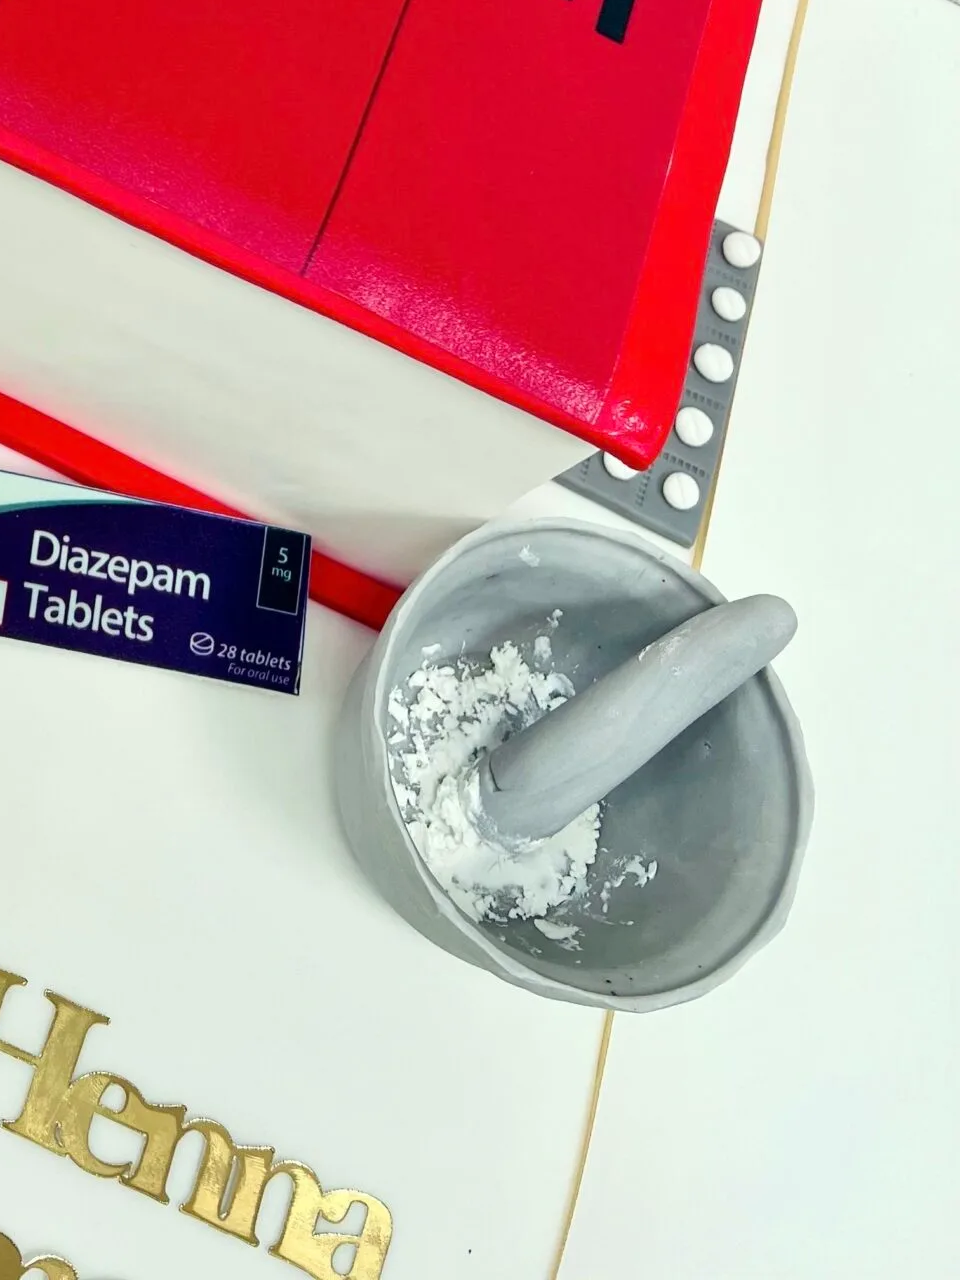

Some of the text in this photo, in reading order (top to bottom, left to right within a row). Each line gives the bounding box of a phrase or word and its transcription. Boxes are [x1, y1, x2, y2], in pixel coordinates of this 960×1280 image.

[29, 528, 211, 601] Diazepam
[277, 547, 289, 564] 5
[271, 566, 292, 582] mg
[23, 581, 155, 643] Tablets
[216, 643, 292, 671] 28 tablets
[227, 662, 290, 686] For oral use
